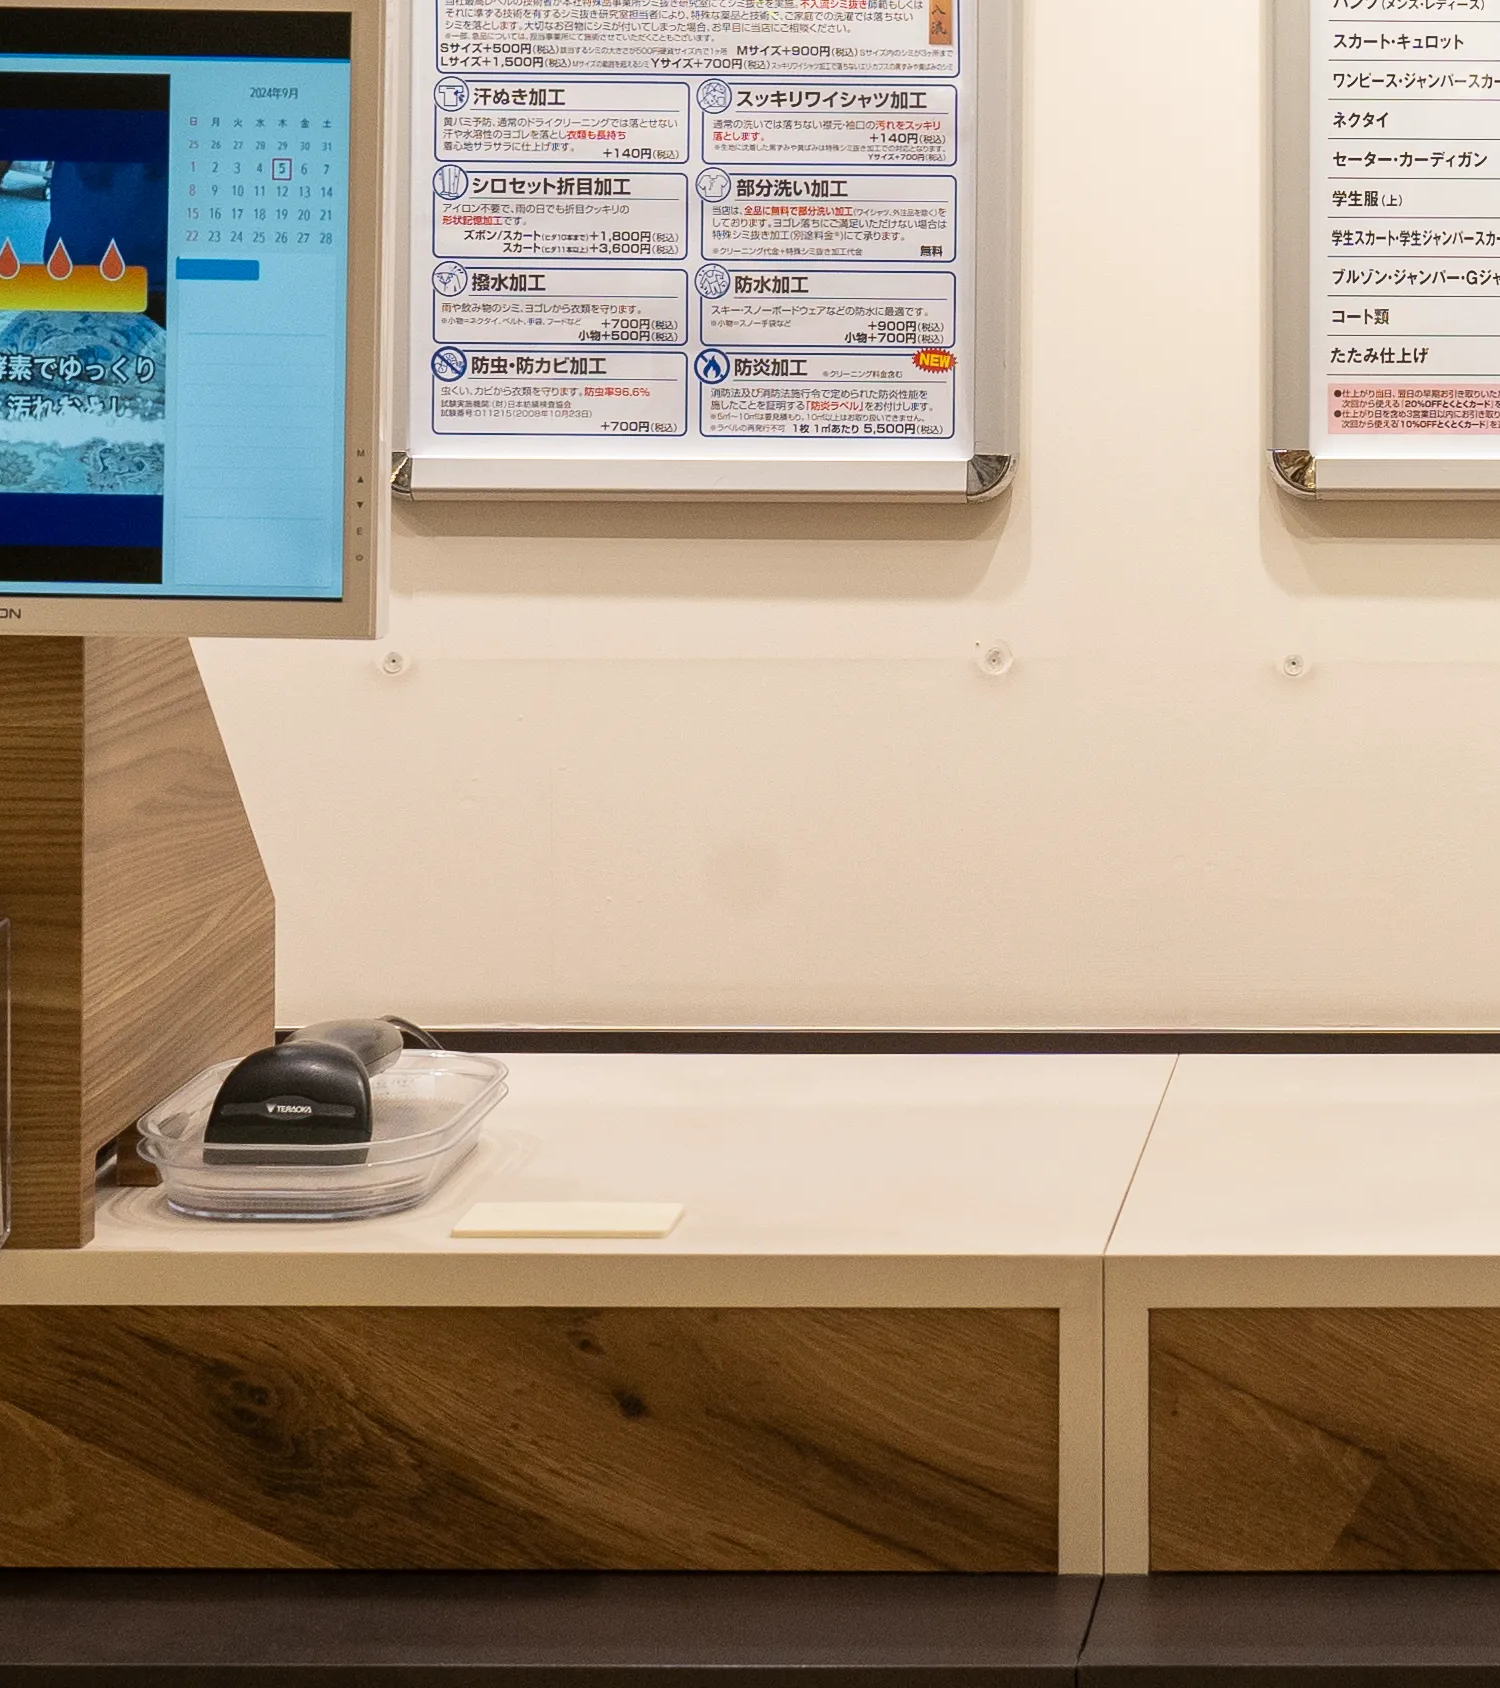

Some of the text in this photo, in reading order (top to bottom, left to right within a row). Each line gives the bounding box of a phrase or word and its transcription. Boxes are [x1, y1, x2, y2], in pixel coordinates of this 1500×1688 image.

[250, 87, 299, 100] 2024年9月
[473, 88, 565, 106] 汗ぬき加工
[736, 91, 927, 109] スッキリワイシャツ加工
[1333, 112, 1389, 128] ネクタイ
[472, 178, 631, 196] シロセット折目加工
[736, 179, 848, 198] 部分洗い加工
[471, 274, 546, 292] 撥水加工
[734, 276, 809, 294] 防水加工
[1332, 308, 1389, 325] コート類
[919, 353, 951, 368] NEW
[1330, 347, 1429, 364] たたみ仕上げ
[471, 357, 607, 375] 防虫・防カビ加工
[734, 359, 808, 376] 防炎加工
